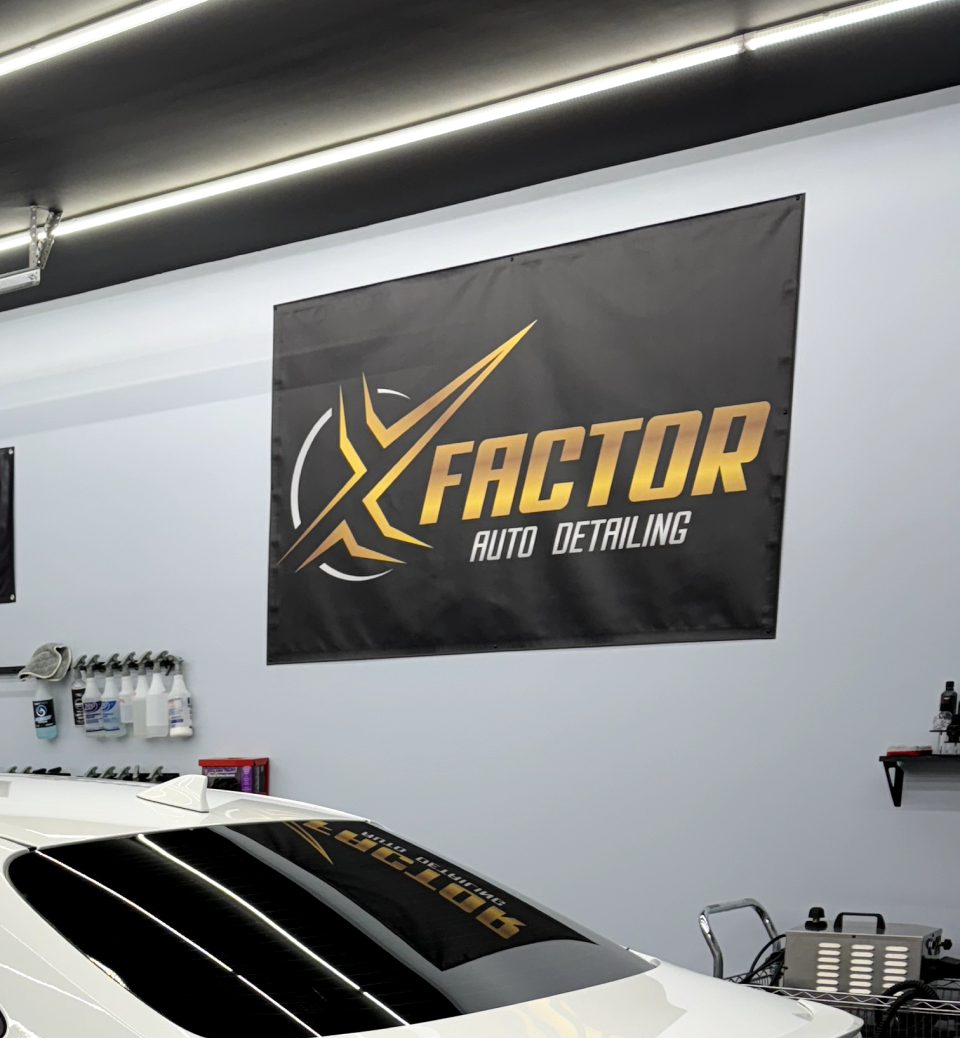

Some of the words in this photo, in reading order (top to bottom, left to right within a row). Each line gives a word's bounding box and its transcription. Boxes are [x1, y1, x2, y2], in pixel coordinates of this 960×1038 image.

[418, 401, 772, 525] FACTOR
[469, 524, 538, 563] AUTO
[551, 510, 692, 556] DETAILING
